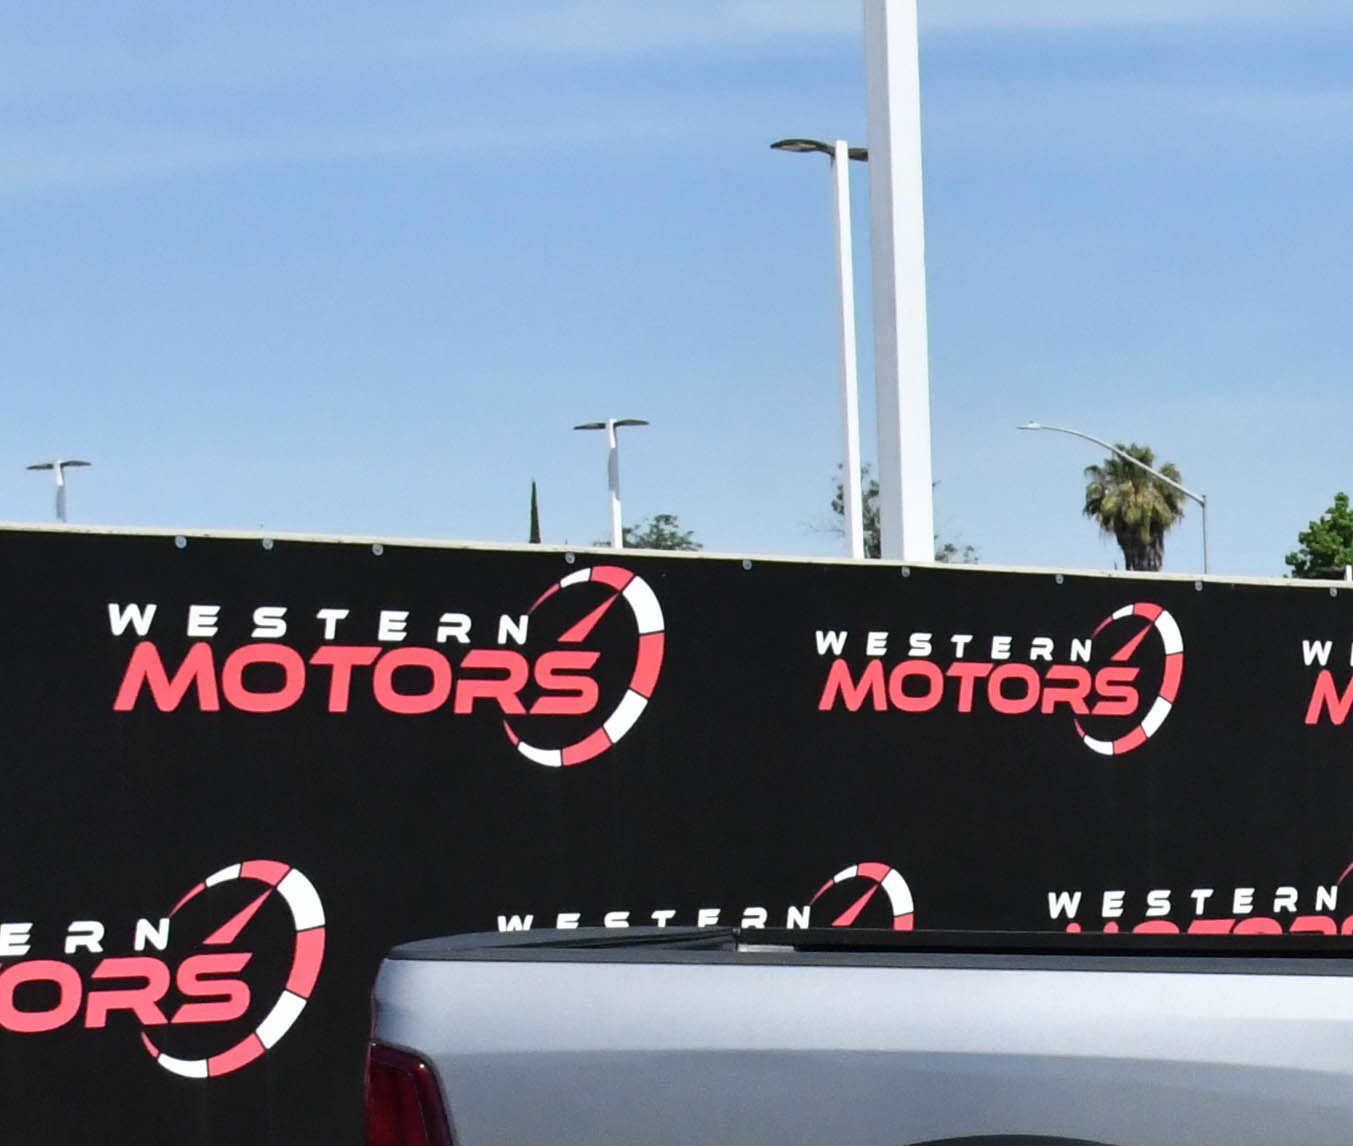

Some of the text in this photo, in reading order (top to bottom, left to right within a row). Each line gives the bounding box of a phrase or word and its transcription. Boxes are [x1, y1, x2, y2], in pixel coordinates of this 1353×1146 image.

[108, 603, 530, 645] WESTERN
[815, 630, 1093, 663] WESTERN
[113, 640, 602, 715] MOTORS
[818, 658, 1140, 716] MOTORS
[1047, 885, 1339, 920] WESTERN
